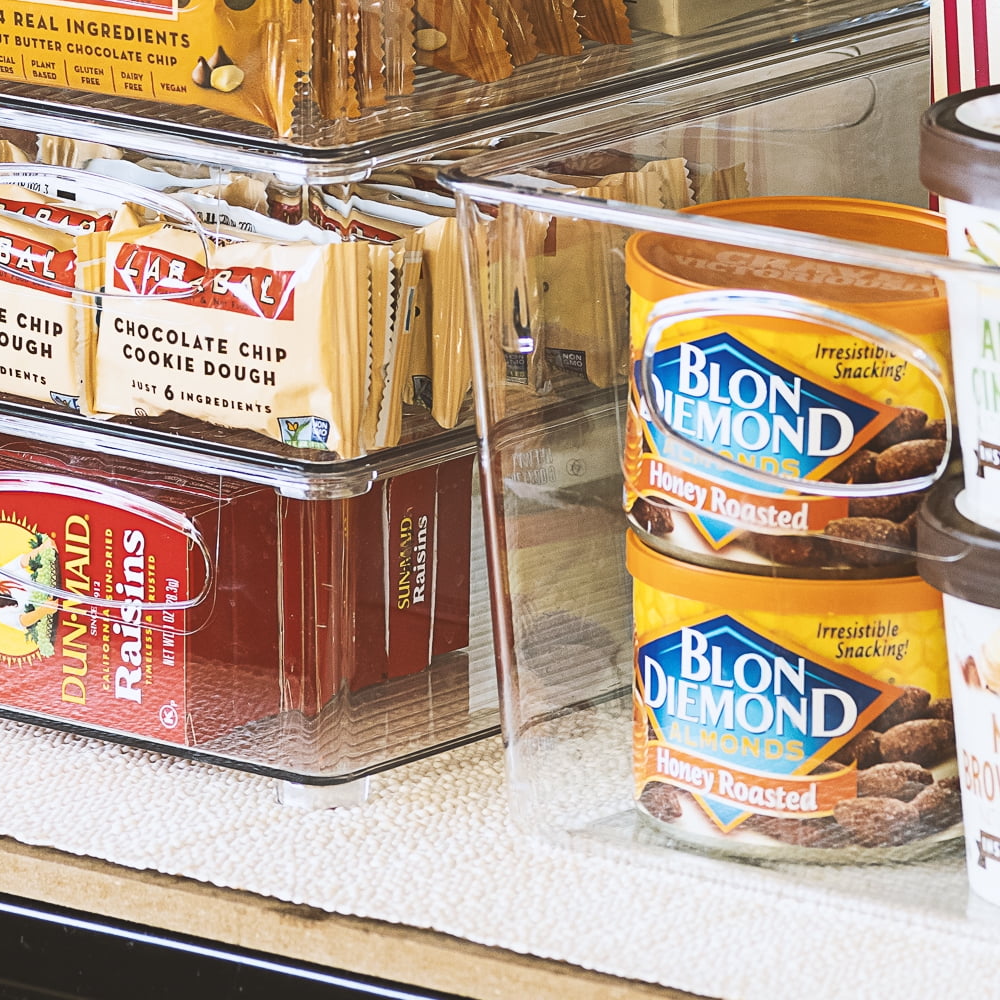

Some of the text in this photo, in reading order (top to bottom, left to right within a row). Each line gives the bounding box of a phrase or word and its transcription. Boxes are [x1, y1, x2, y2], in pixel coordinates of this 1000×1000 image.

[14, 12, 59, 31] REAL
[67, 19, 190, 48] INGREDIENTS
[15, 36, 62, 53] BUTTER
[67, 43, 142, 63] CHOCOLATE
[147, 54, 177, 67] CHIP
[31, 60, 55, 70] PLANT
[74, 65, 104, 75] GLUTEN
[33, 70, 57, 80] BASED
[82, 76, 100, 85] FREE
[121, 72, 143, 81] DAIRY
[125, 82, 143, 91] FREE
[161, 83, 187, 93] VEGAN
[16, 313, 63, 337] CHIP
[114, 318, 287, 363] CHOCOLATE CHIP
[123, 344, 276, 386] COOKIE DOUGH
[679, 342, 802, 415] BLON
[833, 361, 907, 381] Snacking!
[132, 379, 272, 413] JUST 6 INGREDIENTS
[640, 373, 855, 457] DIEMOND
[649, 460, 809, 530] Honey Roasted
[413, 515, 428, 604] Raisins
[102, 529, 113, 691] CALIFORNIA SUN-DRIED
[113, 530, 145, 704] Raisins
[163, 611, 175, 666] NET OZ
[817, 619, 898, 640] Irresistible
[145, 628, 154, 685] TIMELESS
[680, 626, 805, 695] BLON
[836, 639, 909, 660] Snacking!
[644, 655, 858, 738] DIEMOND
[668, 722, 805, 762] ALMONDS
[656, 747, 818, 811] Honey Roasted
